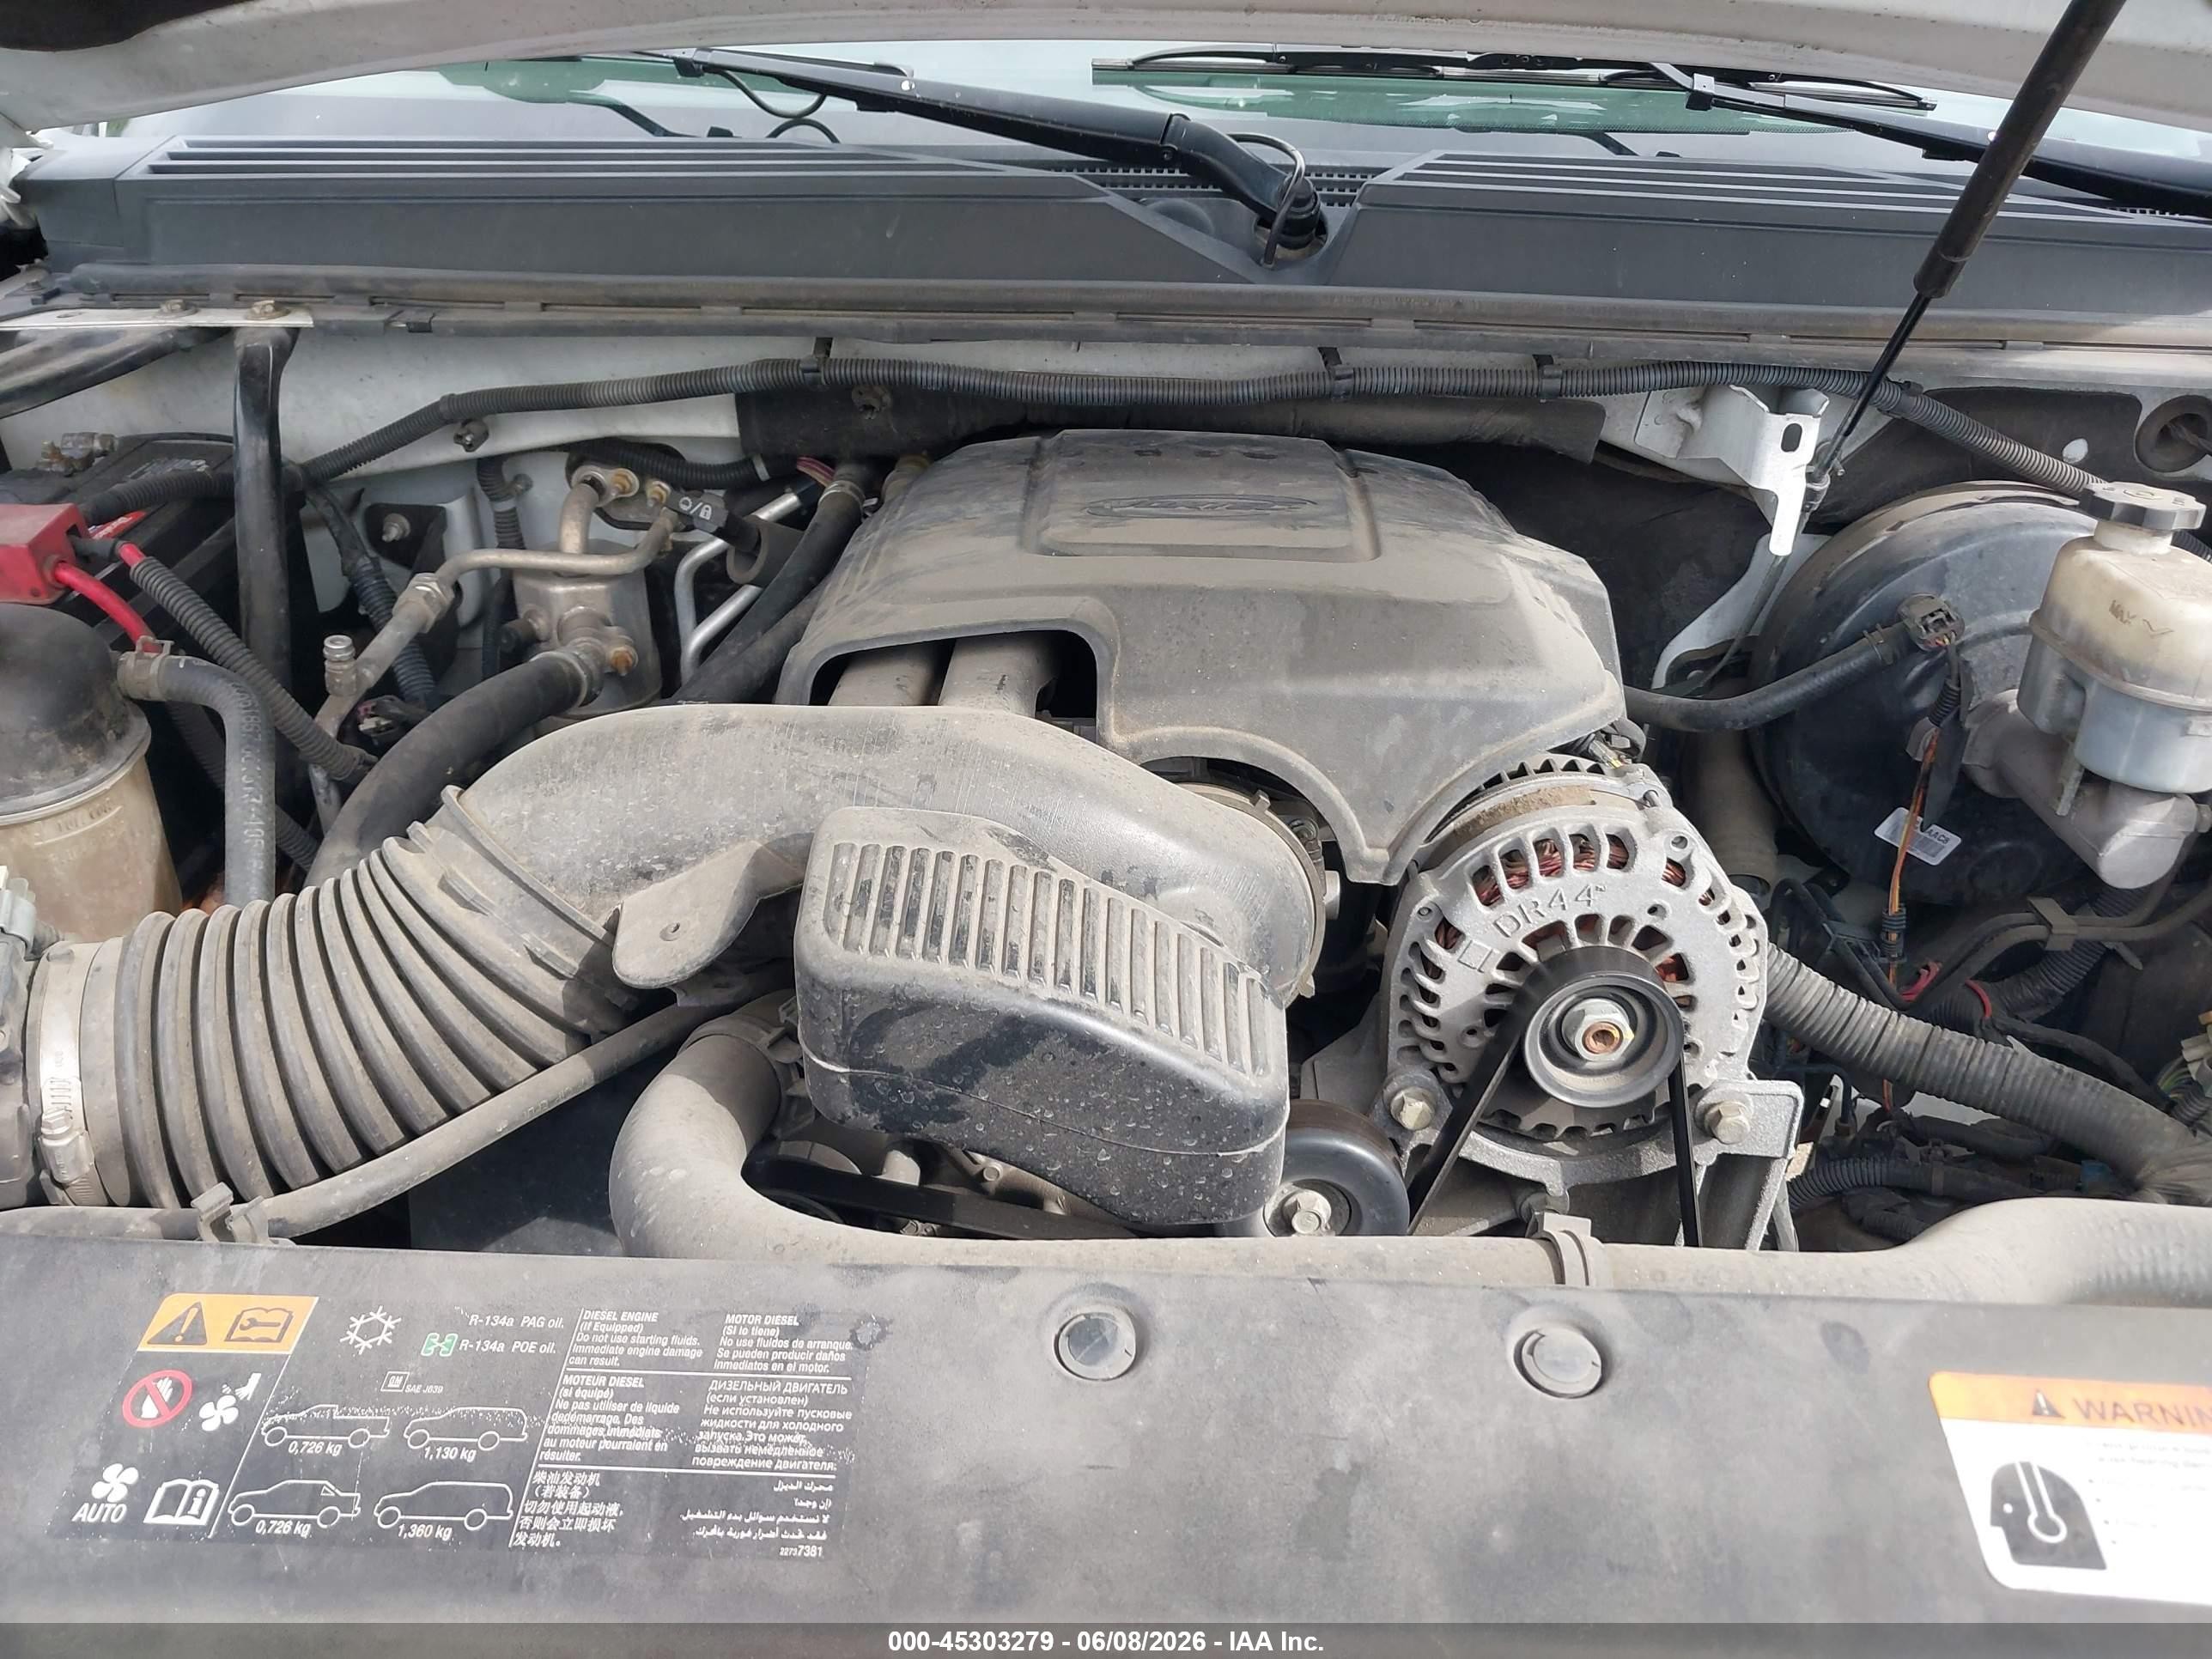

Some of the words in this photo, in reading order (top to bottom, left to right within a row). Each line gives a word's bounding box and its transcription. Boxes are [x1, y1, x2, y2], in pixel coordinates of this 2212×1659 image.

[469, 1314, 514, 1327] R-134a
[520, 1316, 546, 1328] PAG
[547, 1316, 564, 1328] oil.
[583, 1310, 618, 1322] DIESEL
[620, 1311, 659, 1322] ENGINE
[725, 1314, 762, 1325] MOTOR
[763, 1315, 799, 1326] DIESEL
[592, 1322, 644, 1334] Equipped)
[738, 1326, 748, 1335] lo
[750, 1327, 781, 1338] tiene)
[459, 1339, 505, 1352] R-134a
[512, 1340, 538, 1353] POE
[539, 1341, 556, 1354] oil.
[576, 1333, 590, 1342] Do
[592, 1334, 609, 1343] not
[630, 1334, 669, 1346] starting
[671, 1335, 701, 1346] fluids.
[720, 1336, 733, 1346] No
[736, 1338, 754, 1347] use
[756, 1338, 789, 1348] fluidos
[792, 1338, 804, 1349] de
[573, 1344, 624, 1355] Immediate
[627, 1346, 661, 1358] engine
[662, 1347, 703, 1359] damage
[716, 1347, 730, 1358] Se
[732, 1349, 769, 1359] pueden
[771, 1349, 816, 1361] producir
[816, 1351, 846, 1362] daños
[568, 1356, 586, 1365] can
[589, 1356, 620, 1366] result.
[771, 1362, 784, 1371] en
[787, 1361, 796, 1371] el
[798, 1362, 830, 1373] motor.
[388, 1376, 403, 1387] GM
[562, 1375, 606, 1387] MOTEUR
[608, 1376, 644, 1388] DIESEL
[708, 1379, 781, 1393] ДИЗЕЛЬНЫЙ
[782, 1381, 848, 1395] ДВИГАТЕЛЬ
[404, 1384, 422, 1393] SAE
[422, 1385, 444, 1394] J639
[574, 1387, 614, 1400] équipé)
[555, 1399, 569, 1410] Ne
[571, 1401, 590, 1412] pas
[592, 1400, 628, 1412] utiliser
[629, 1401, 643, 1413] de
[645, 1401, 680, 1414] liquide
[706, 1392, 737, 1403] (если
[739, 1394, 809, 1407] установлен)
[623, 1413, 644, 1425] Des
[703, 1404, 720, 1415] Не
[722, 1406, 794, 1419] используйте
[797, 1410, 852, 1421] пусковые
[700, 1418, 757, 1429] жидкости
[757, 1419, 780, 1431] для
[782, 1421, 844, 1432] холодного
[288, 1441, 322, 1455] 0,726
[325, 1441, 343, 1456] kg
[544, 1437, 556, 1448] au
[558, 1437, 597, 1449] moteur
[598, 1438, 653, 1451] pourraient
[654, 1442, 667, 1451] en
[695, 1443, 743, 1454] вызвать
[424, 1446, 459, 1460] 1,130
[460, 1447, 477, 1462] kg
[539, 1448, 581, 1461] résulter.
[692, 1455, 773, 1468] повреждение
[532, 1470, 600, 1486] 柴油发动机
[71, 1502, 128, 1523] AUTO
[255, 1519, 292, 1534] 0,726
[294, 1521, 311, 1538] kg
[397, 1523, 433, 1538] 1,360
[435, 1525, 452, 1540] kg
[519, 1516, 617, 1533] 否则会立即损坏
[514, 1531, 561, 1547] 发动机。
